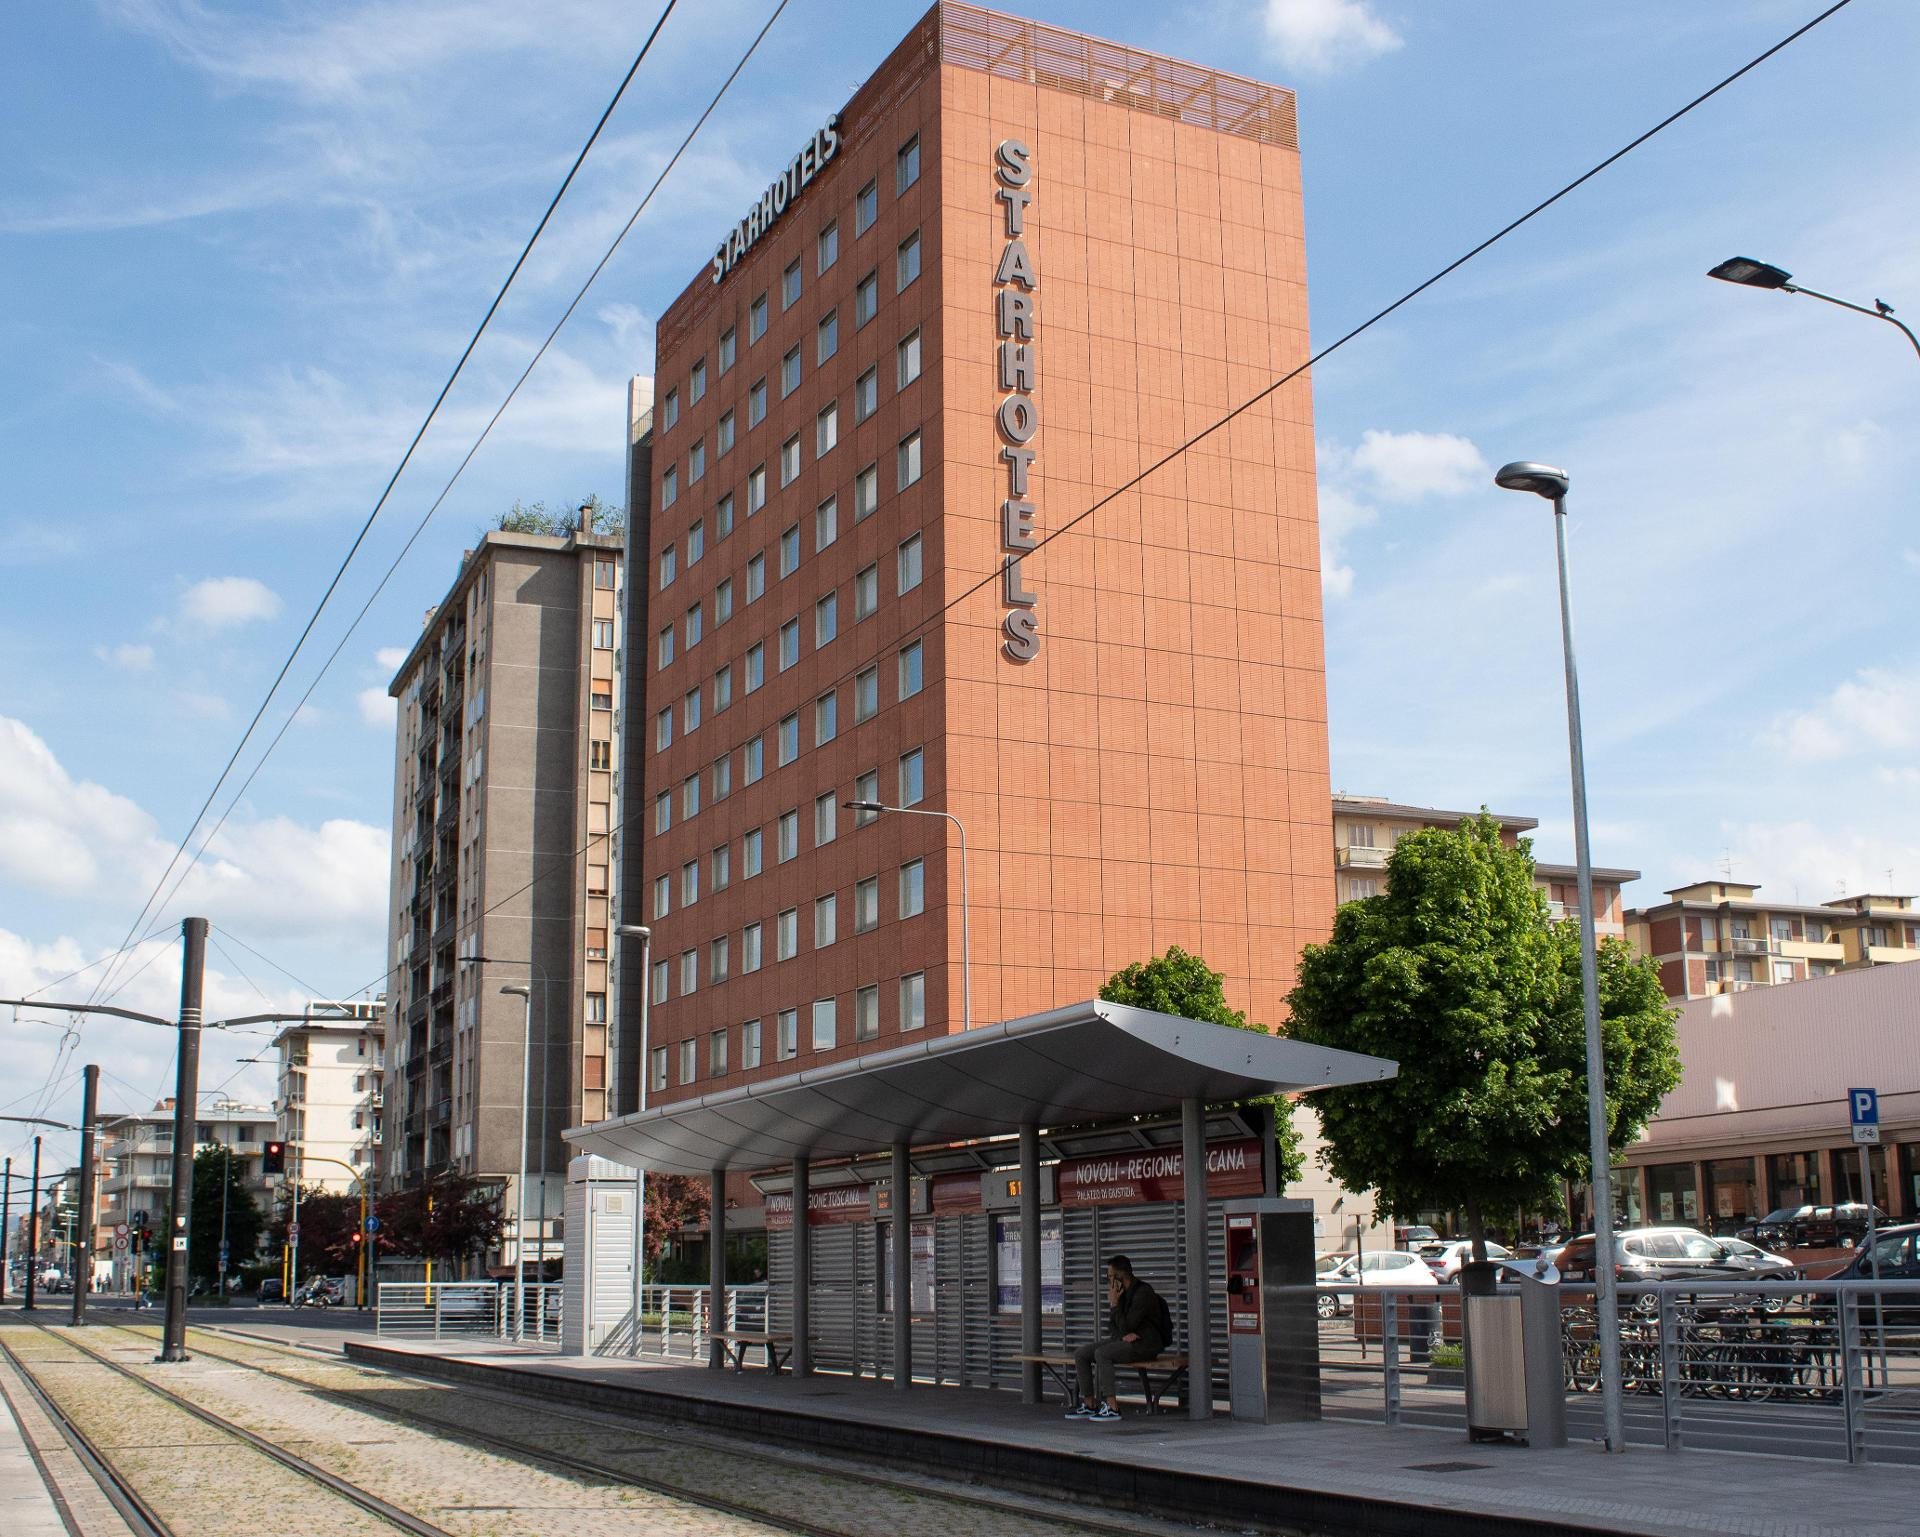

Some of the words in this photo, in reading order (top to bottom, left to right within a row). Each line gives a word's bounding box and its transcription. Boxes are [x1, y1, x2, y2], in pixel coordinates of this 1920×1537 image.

[712, 113, 840, 285] STARHOTELS
[994, 139, 1040, 662] STARHOTELS
[1855, 1093, 1872, 1120] P
[1076, 1160, 1119, 1185] NOVOLI
[1127, 1154, 1182, 1180] REGIONE
[1205, 1148, 1246, 1174] CANA
[770, 1195, 793, 1213] NOVOL
